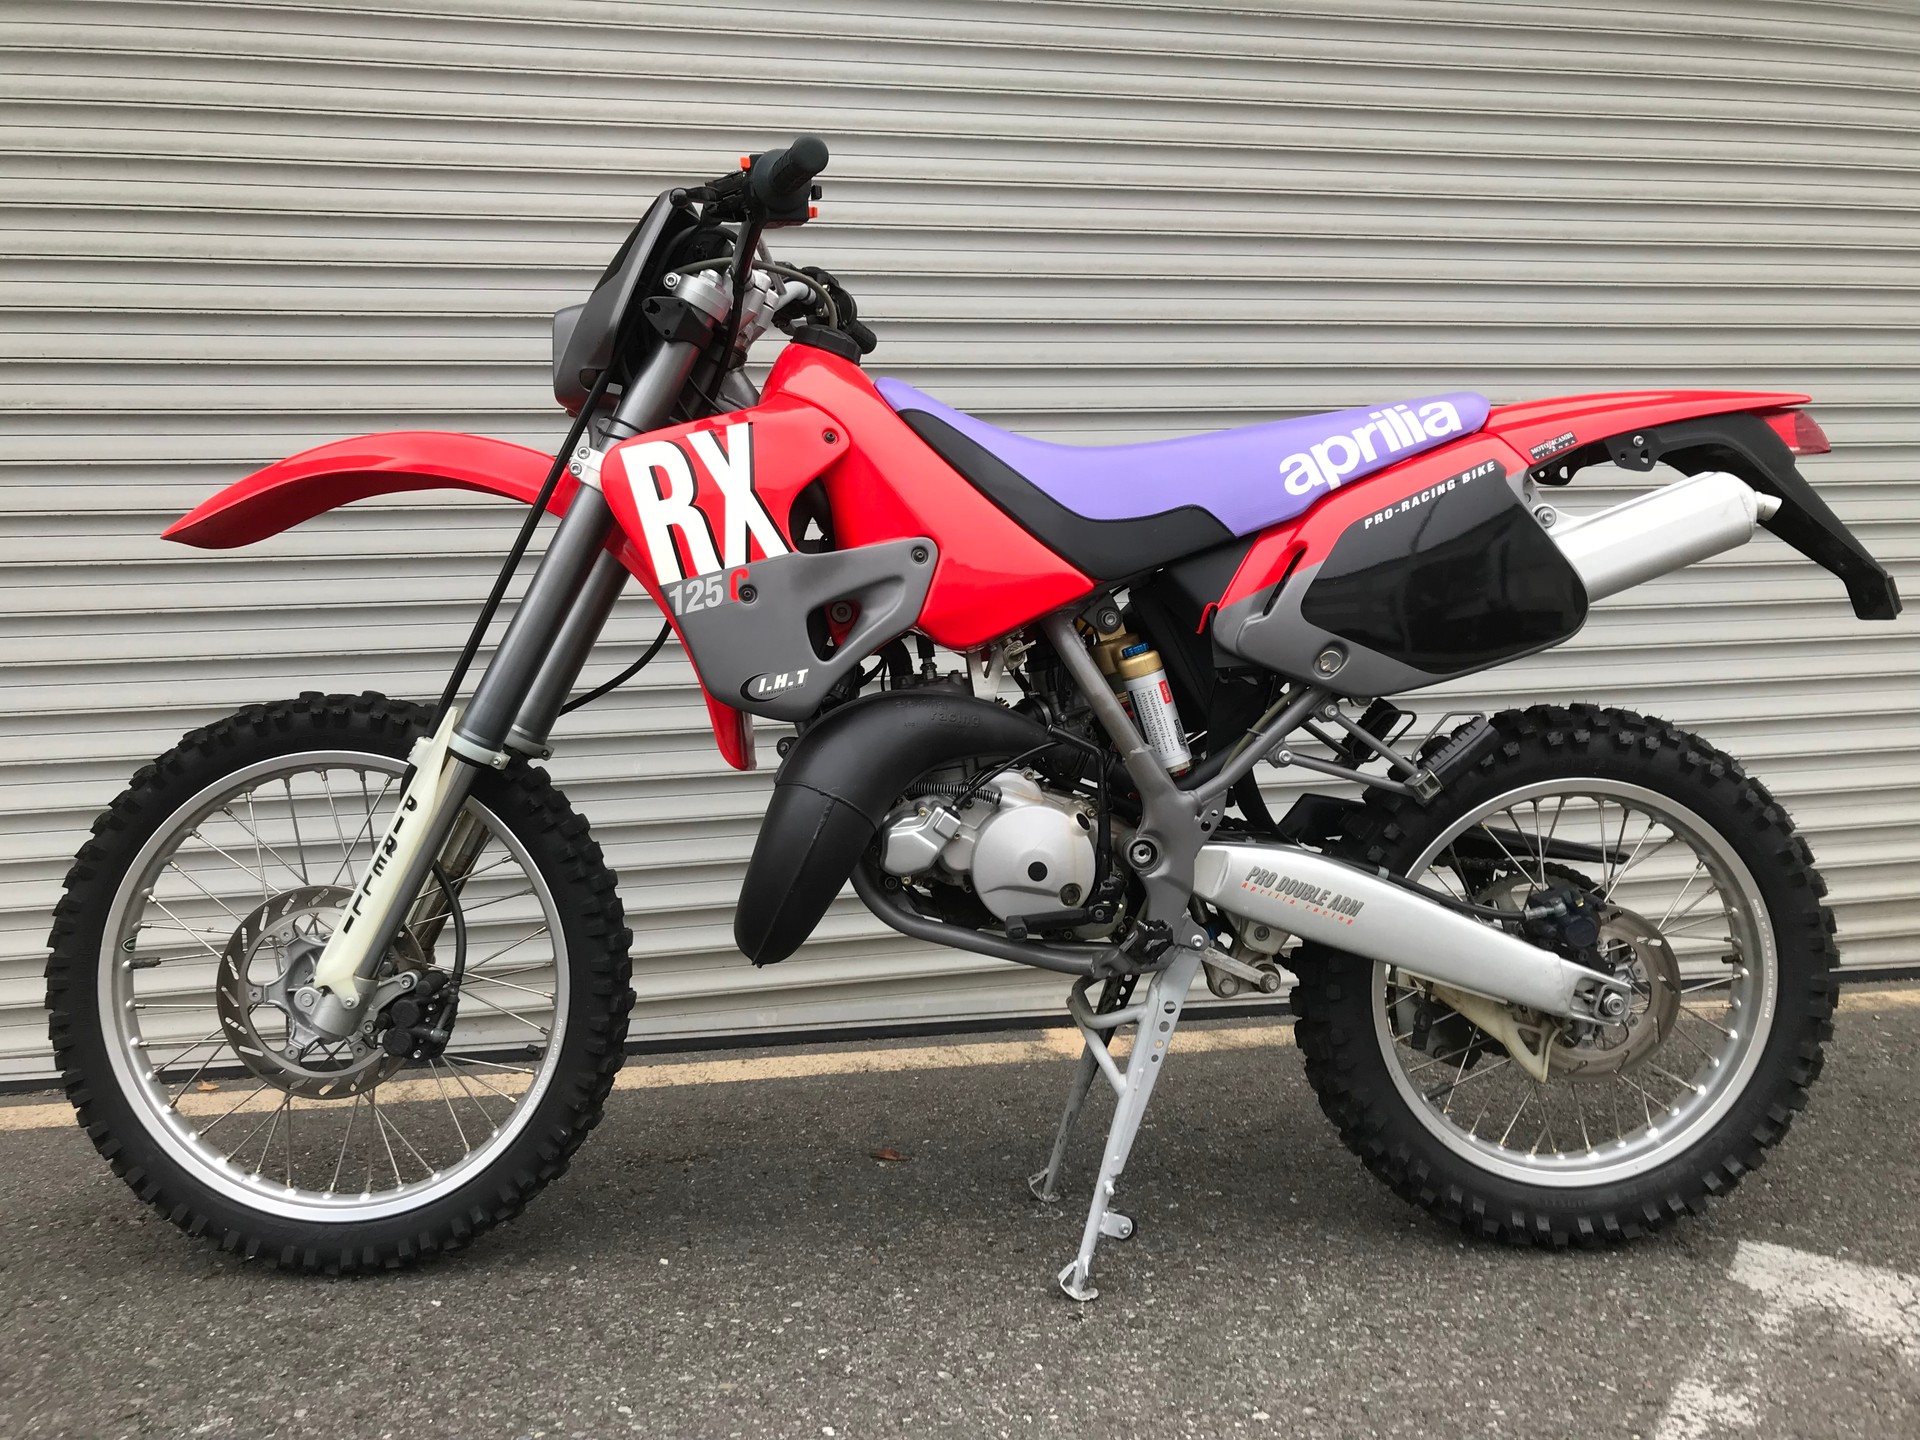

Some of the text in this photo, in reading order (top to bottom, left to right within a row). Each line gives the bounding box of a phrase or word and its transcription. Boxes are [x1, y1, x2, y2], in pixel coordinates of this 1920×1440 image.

[1279, 401, 1462, 495] aprilia
[619, 422, 795, 586] RX
[1364, 461, 1496, 529] PRO-RACING BIKE
[668, 574, 724, 617] 125
[343, 794, 418, 934] PIRELLI
[1245, 866, 1365, 918] PRO DOUBLE ARM
